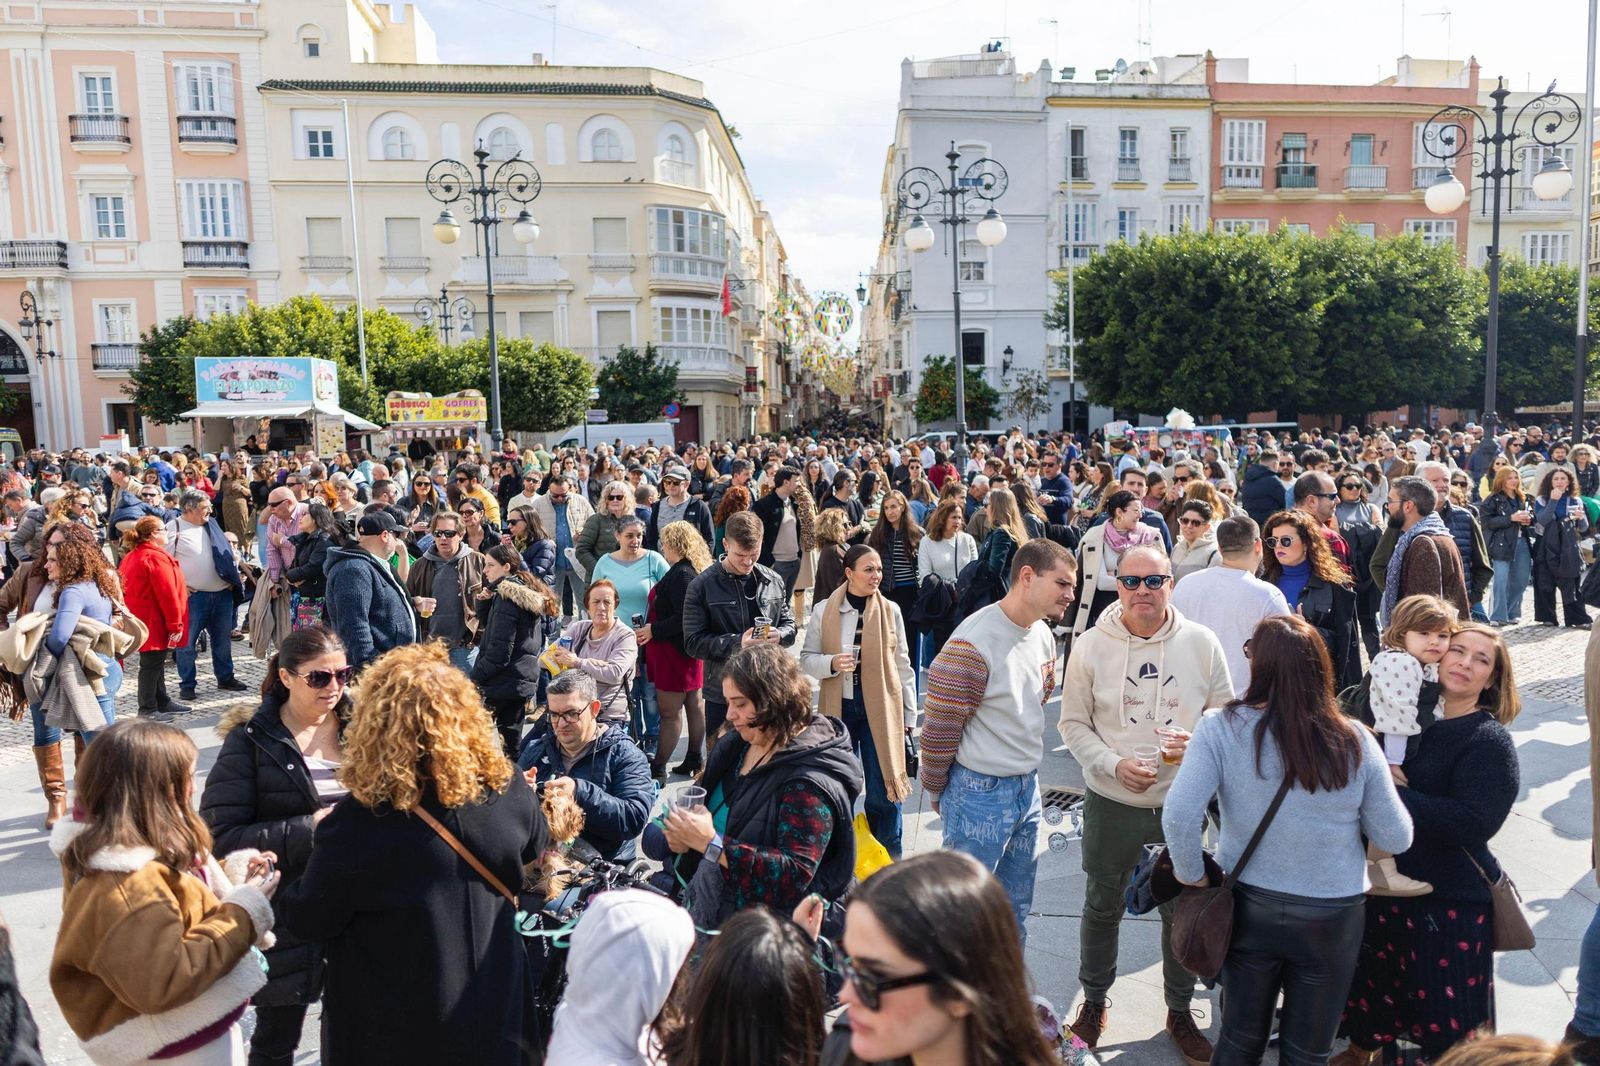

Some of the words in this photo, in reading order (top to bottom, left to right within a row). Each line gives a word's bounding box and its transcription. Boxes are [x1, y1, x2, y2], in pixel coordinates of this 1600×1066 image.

[213, 379, 227, 392] EL
[230, 379, 297, 392] PAPONAZO
[390, 400, 430, 408] BUÑUELOS
